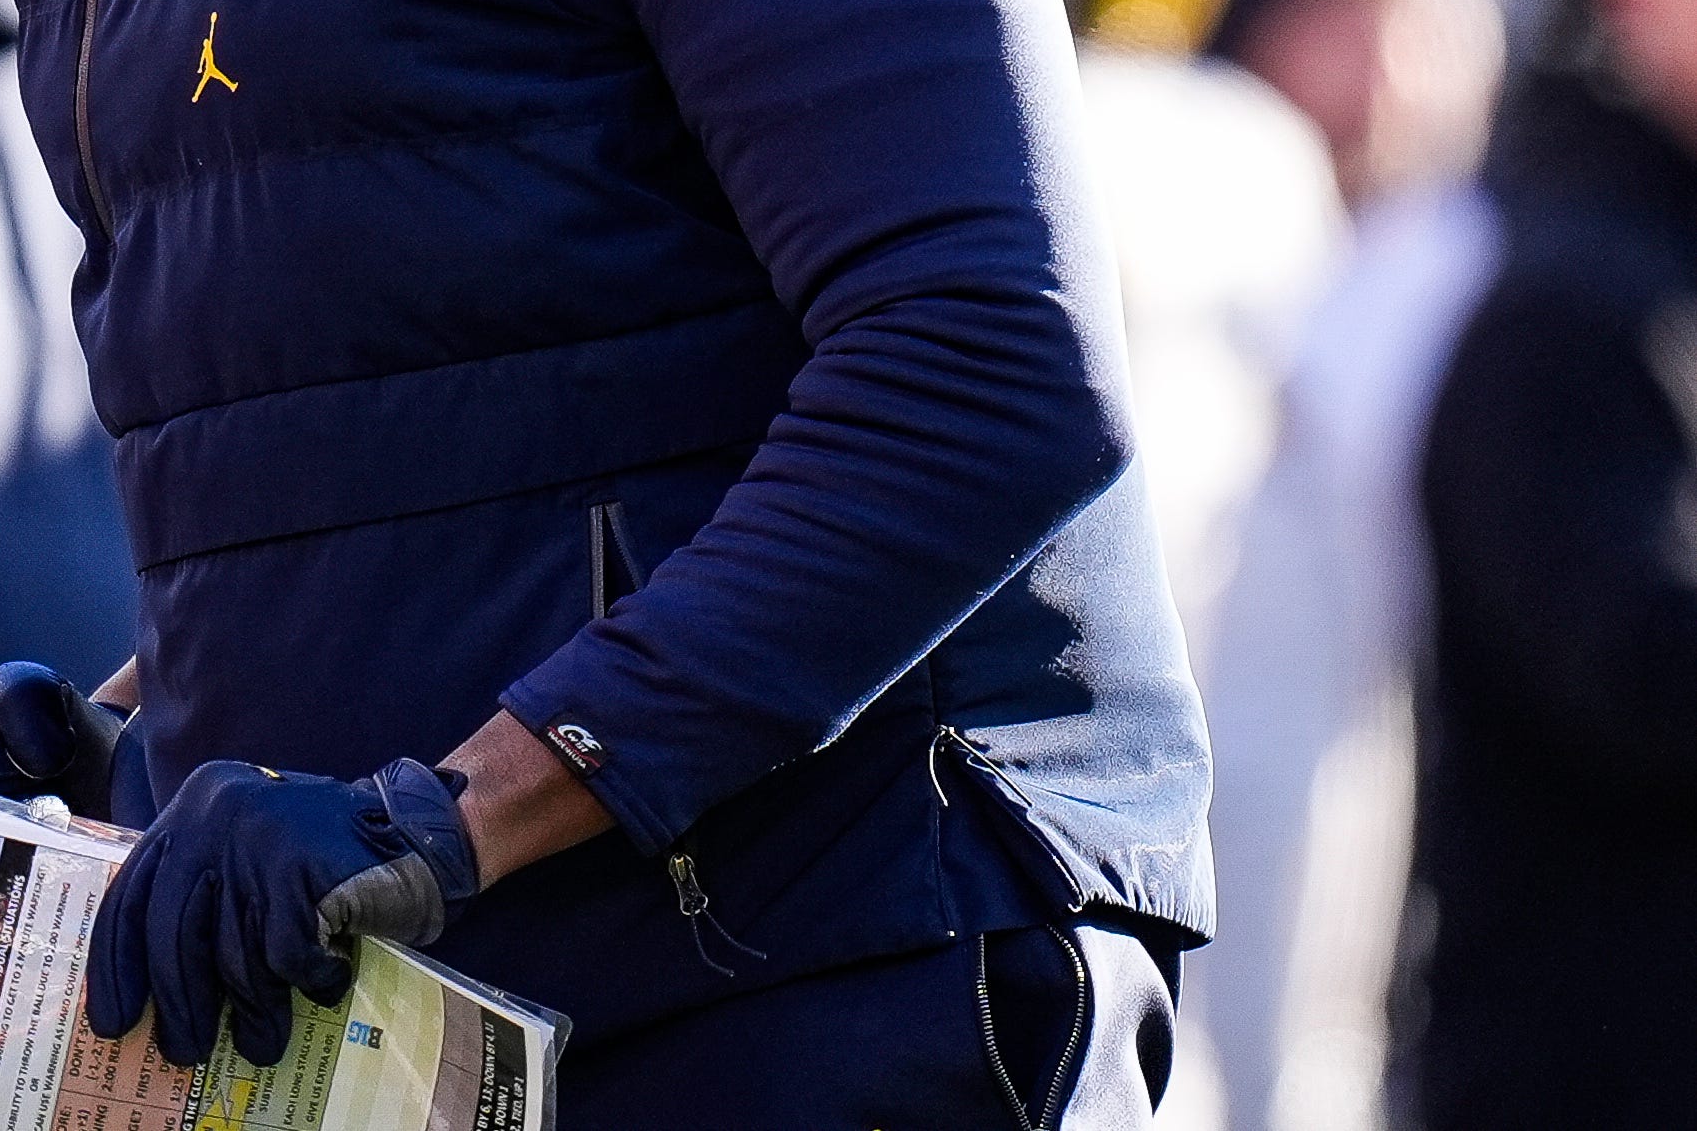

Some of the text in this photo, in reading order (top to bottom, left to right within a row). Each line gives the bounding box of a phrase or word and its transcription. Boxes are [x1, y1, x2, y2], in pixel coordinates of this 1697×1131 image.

[1, 875, 25, 941] SITUATIONS
[54, 883, 70, 929] WARNING
[44, 955, 53, 966] TO
[13, 971, 22, 983] TO
[39, 970, 49, 990] DUE
[66, 962, 79, 995] COUNT
[8, 988, 18, 1004] GET
[33, 993, 44, 1014] BALL
[5, 1007, 13, 1019] TO
[59, 999, 71, 1025] HARD
[29, 1019, 38, 1035] THE
[56, 1028, 64, 1040] AS
[20, 1038, 34, 1074] THROW
[44, 1043, 62, 1089] WARNING
[70, 1037, 87, 1076] DON'T
[102, 1065, 117, 1091] 2:00
[191, 1062, 206, 1097] CLOCK
[317, 1054, 330, 1084] EXTRA
[16, 1078, 25, 1089] TO
[31, 1078, 40, 1091] OR
[137, 1066, 152, 1098] FIRST
[313, 1086, 323, 1098] US
[476, 1112, 489, 1128] BY
[483, 1054, 495, 1084] DOWN
[40, 1093, 50, 1111] USE
[186, 1099, 198, 1120] THE
[307, 1101, 319, 1122] GIVE
[494, 1091, 508, 1126] DOWN
